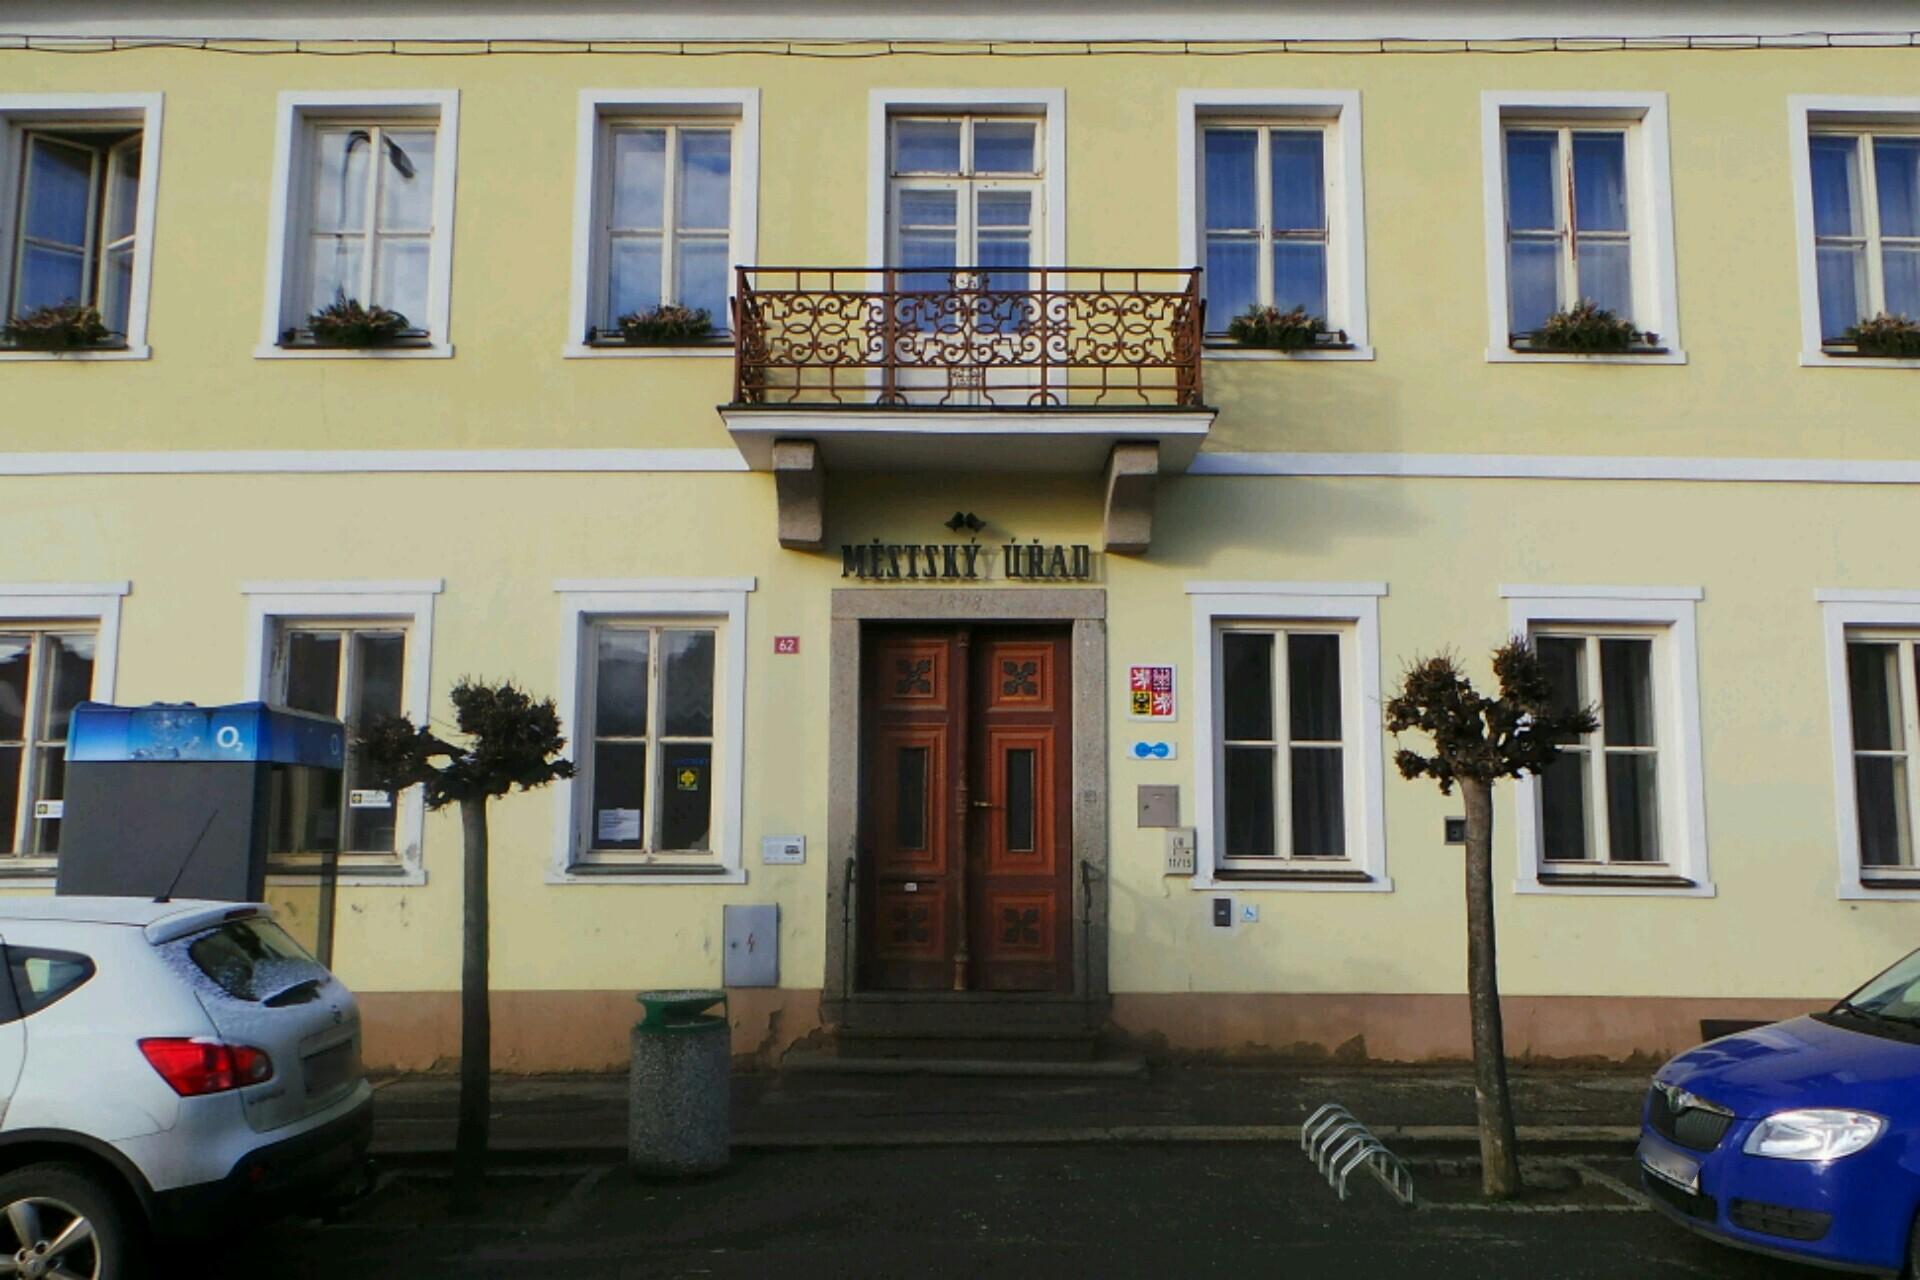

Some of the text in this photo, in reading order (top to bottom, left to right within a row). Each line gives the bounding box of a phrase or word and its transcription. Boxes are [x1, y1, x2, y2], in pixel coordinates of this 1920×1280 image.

[841, 537, 1090, 578] MĚSTSKÝ ÚŘAD
[779, 639, 795, 651] 62
